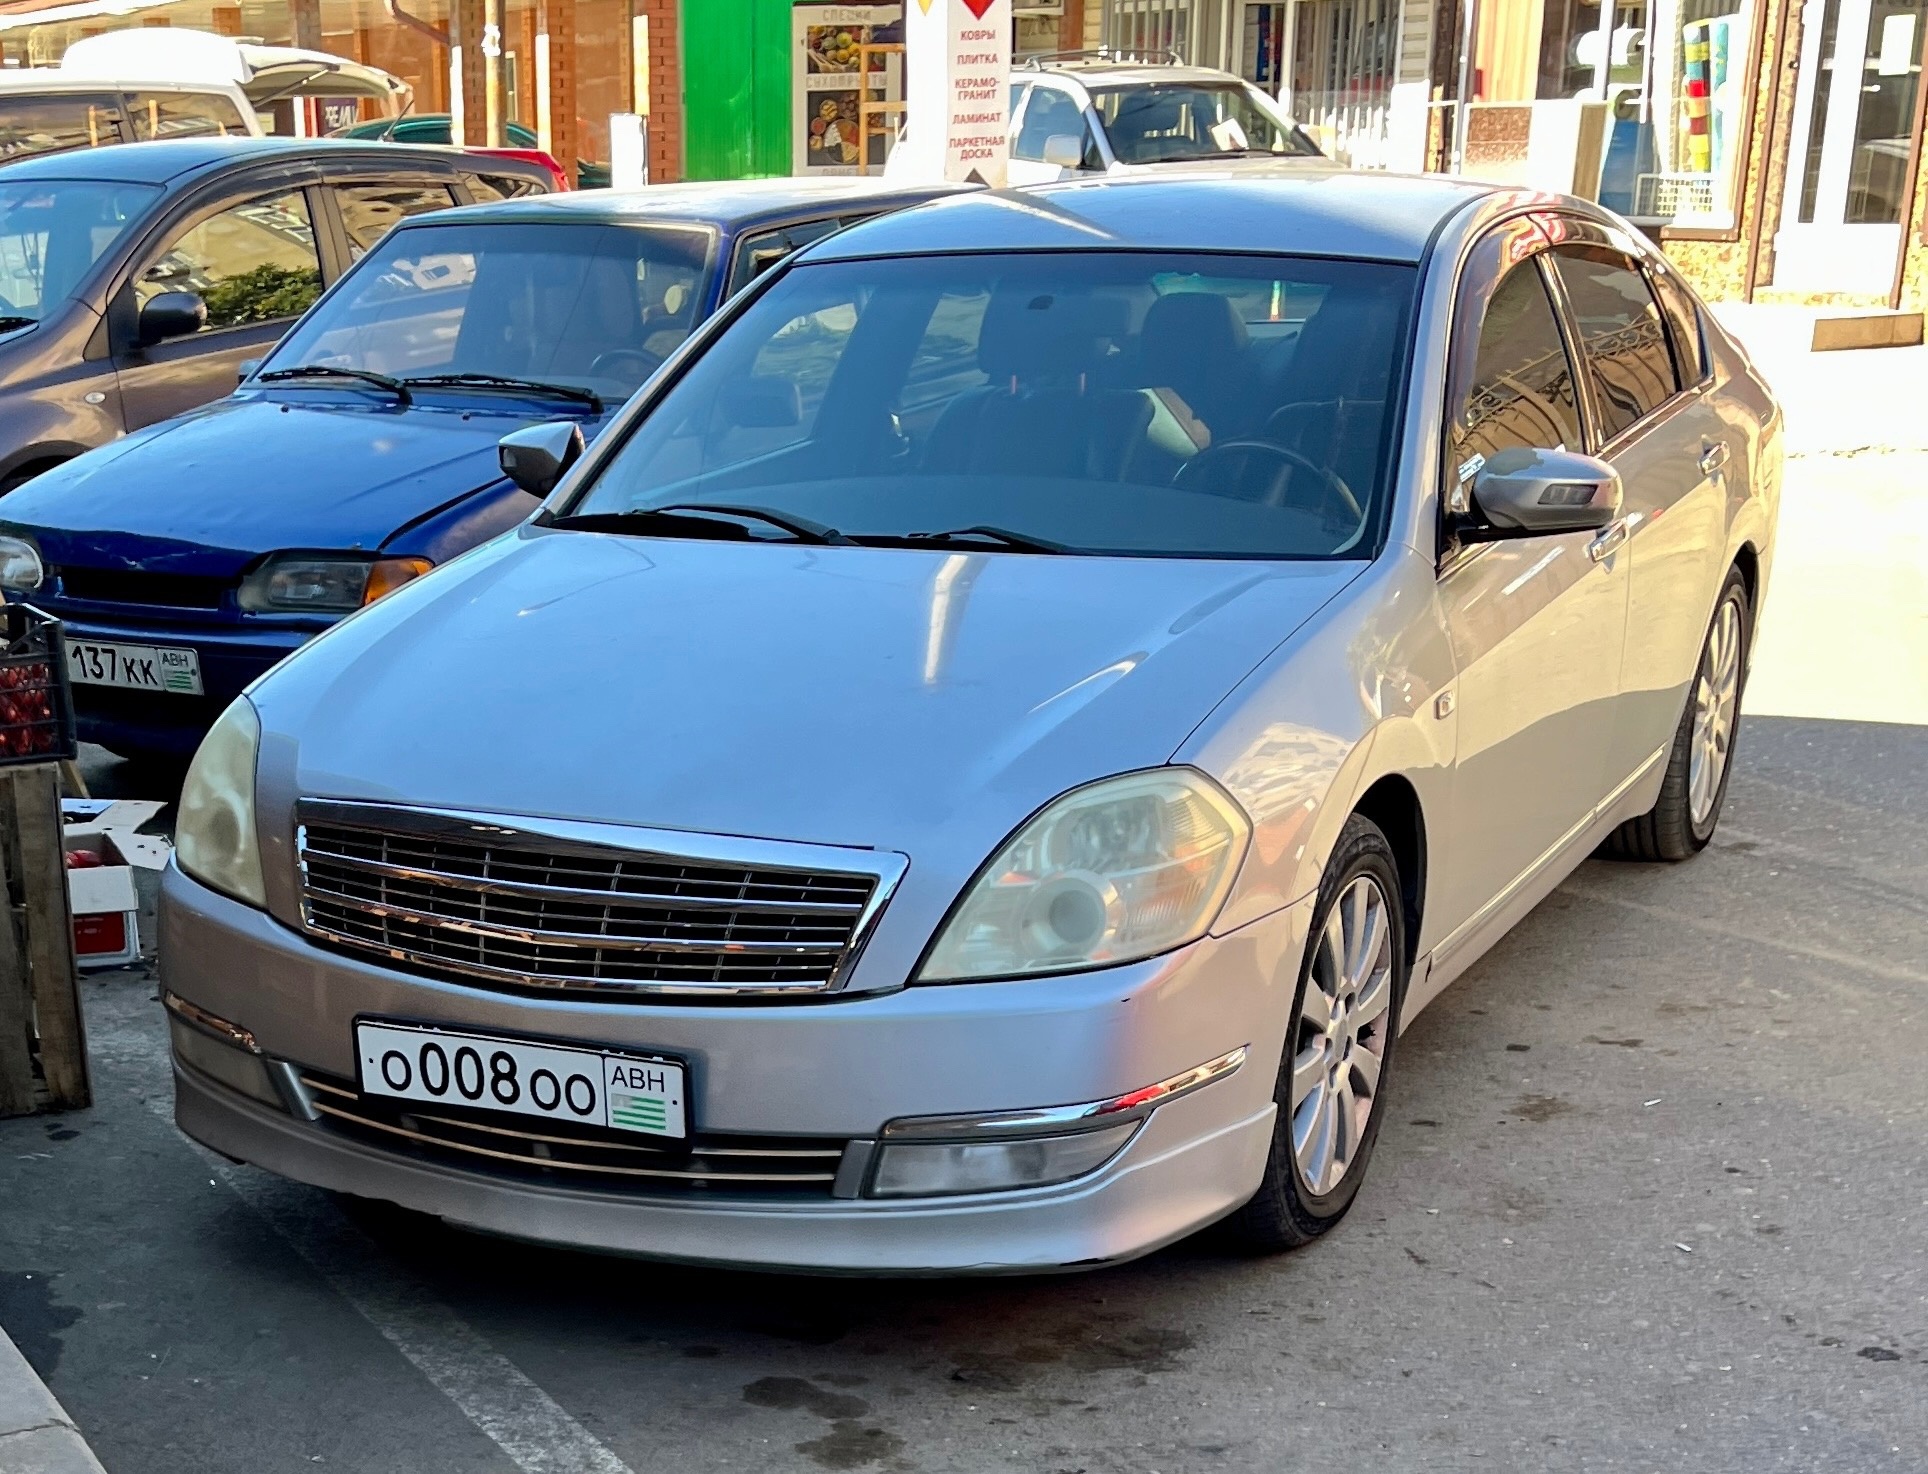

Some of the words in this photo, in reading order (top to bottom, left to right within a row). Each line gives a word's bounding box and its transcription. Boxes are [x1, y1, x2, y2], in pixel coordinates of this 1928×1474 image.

[960, 29, 996, 40] КОВРЫ
[957, 53, 998, 65] ПЛИТКА
[955, 77, 1000, 88] КЕРАМО-
[958, 89, 997, 100] ГРАНИТ
[952, 112, 1002, 125] ЛАМИНАТ
[949, 135, 1005, 148] ПАРКЕТНАЯ
[960, 148, 993, 161] ДОСКА
[162, 652, 189, 667] ABH
[610, 1065, 666, 1093] ABH
